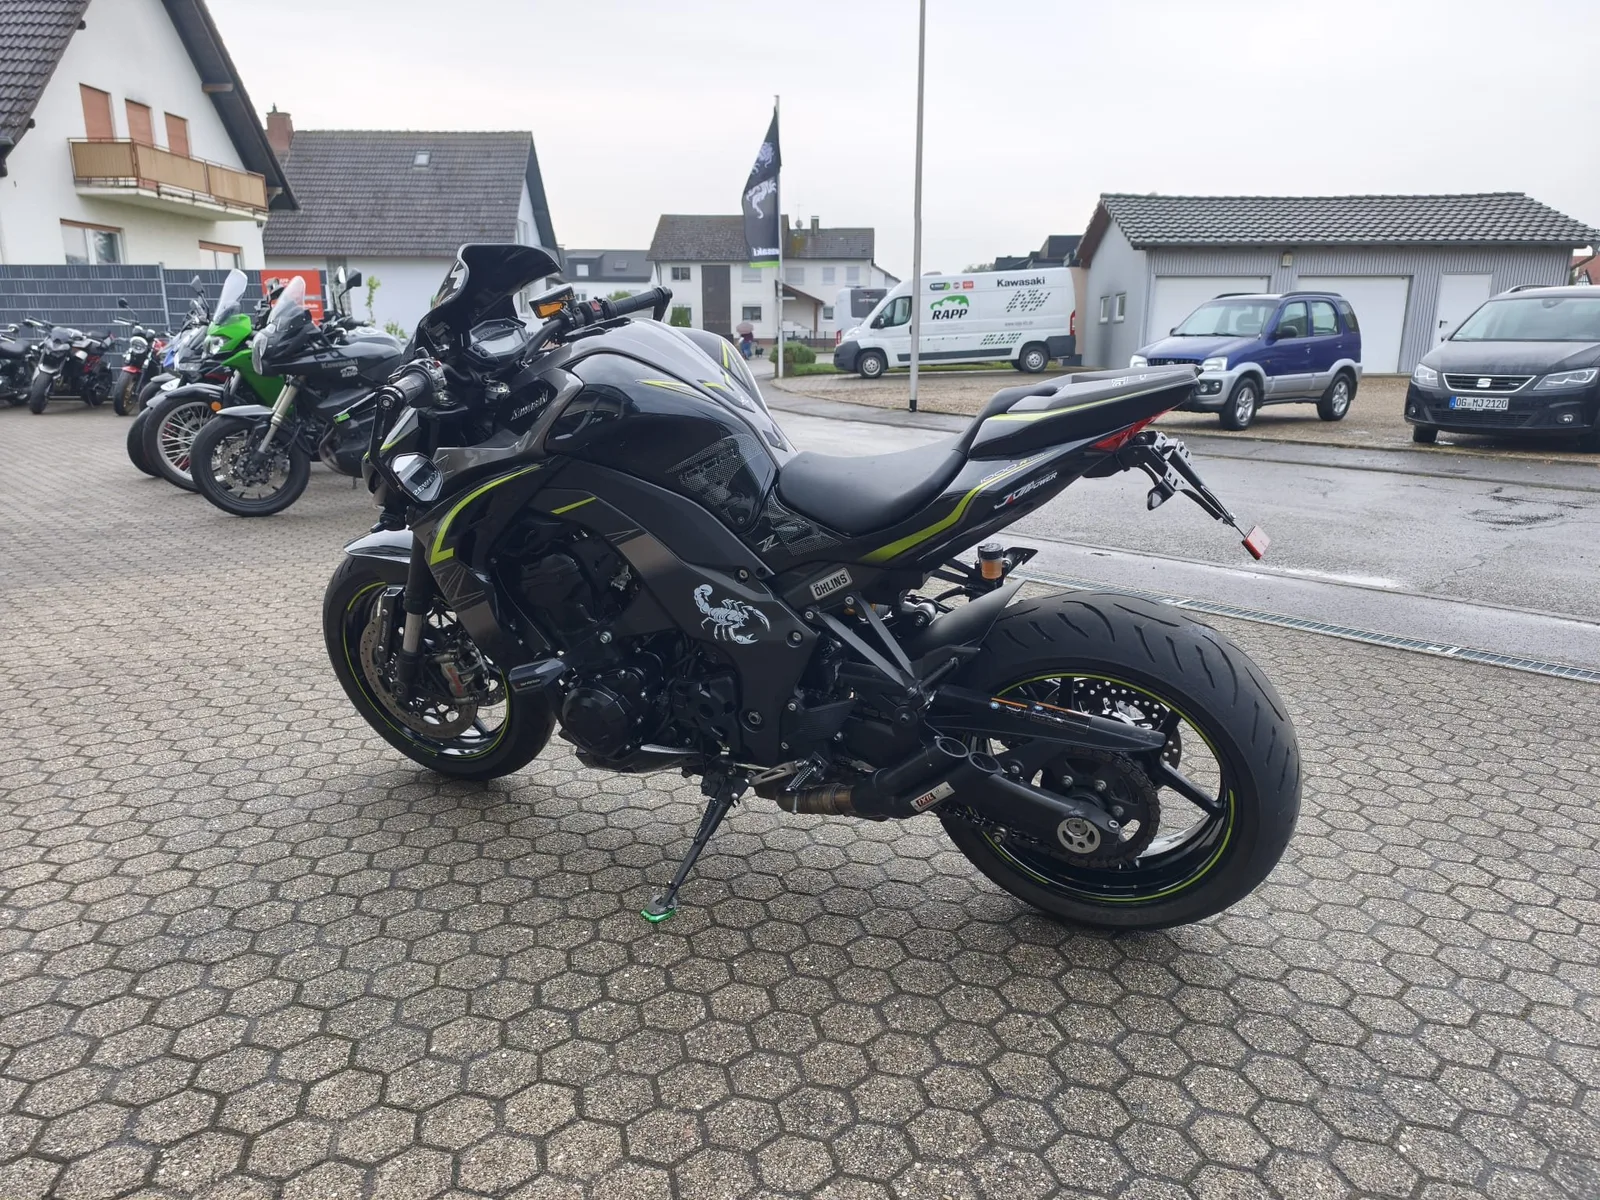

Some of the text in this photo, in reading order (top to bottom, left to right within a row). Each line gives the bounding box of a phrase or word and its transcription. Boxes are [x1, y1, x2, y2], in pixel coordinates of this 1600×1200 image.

[996, 276, 1046, 287] Kawasaki
[932, 308, 968, 320] RAPP
[1456, 397, 1467, 407] OG
[1485, 399, 1507, 408] 2120
[813, 574, 848, 597] ÖHLINS
